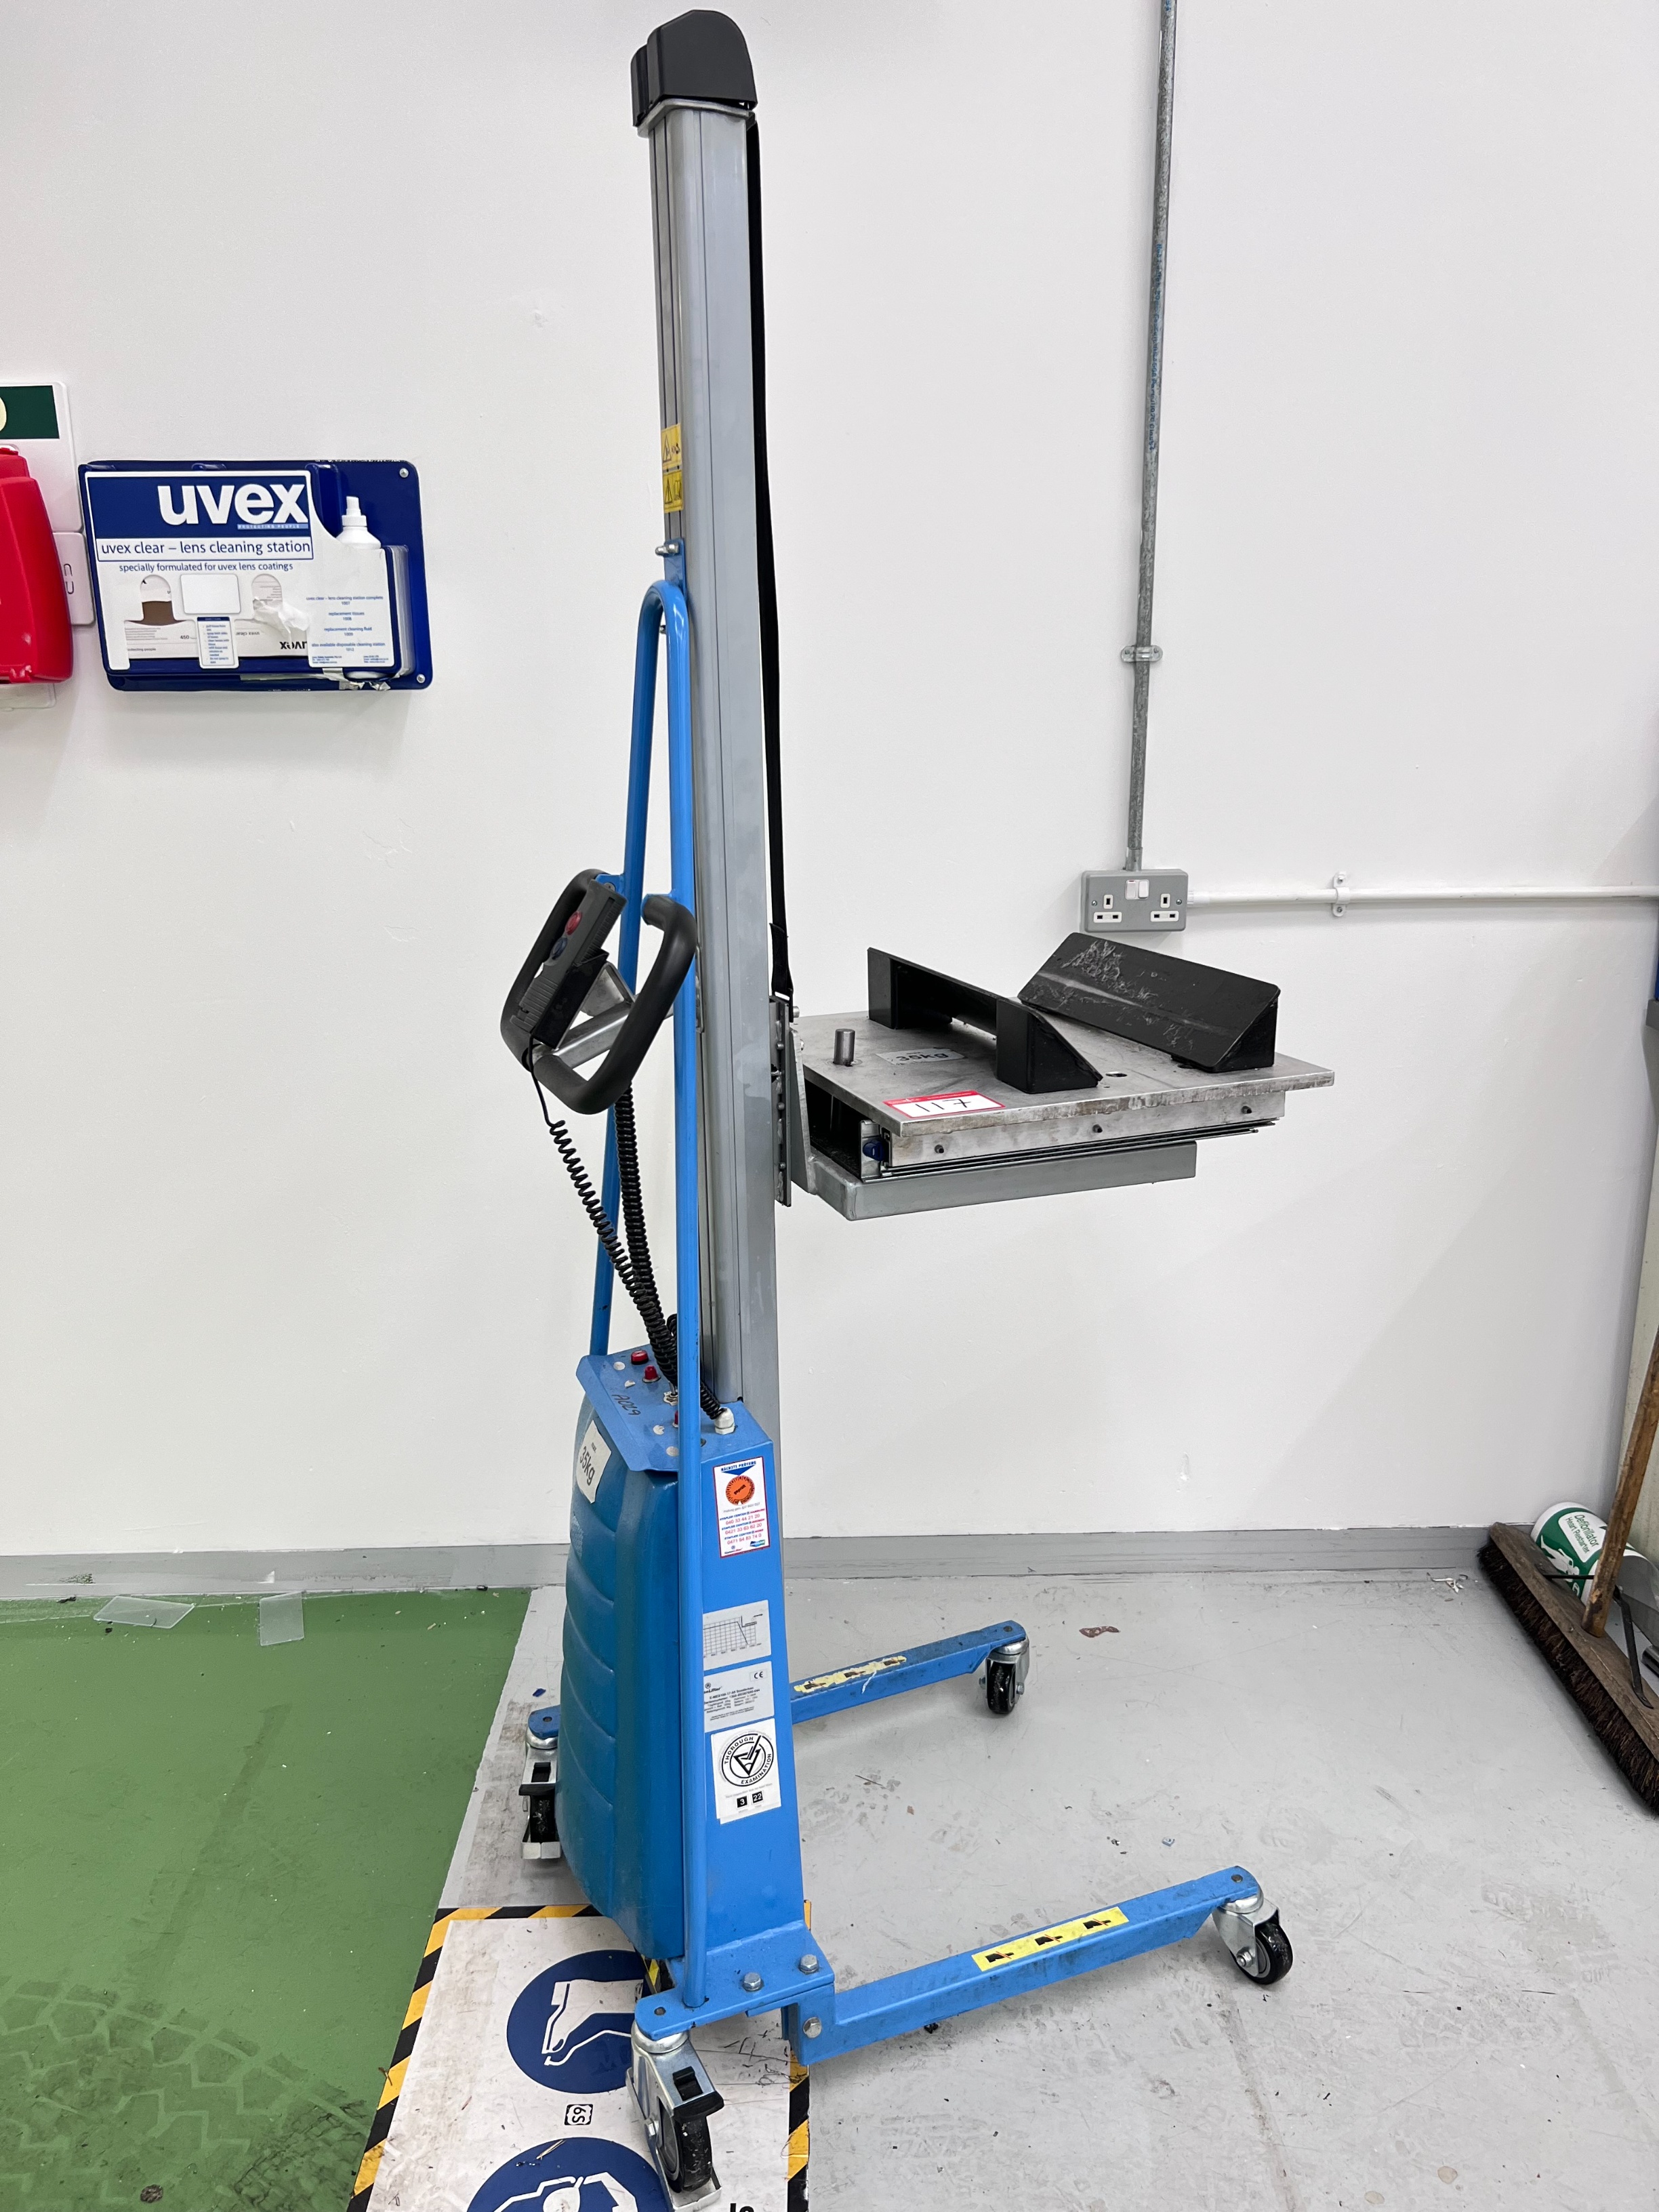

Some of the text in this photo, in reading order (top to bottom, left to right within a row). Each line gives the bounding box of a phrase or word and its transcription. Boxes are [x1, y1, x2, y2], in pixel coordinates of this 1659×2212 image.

[157, 483, 308, 525] uvex
[102, 544, 131, 554] uvex
[134, 541, 165, 554] clear
[180, 541, 205, 553] lens
[209, 541, 263, 555] cleaning
[267, 540, 310, 552] station
[119, 563, 155, 573] specially
[157, 562, 202, 571] formulated
[205, 562, 216, 571] for
[239, 562, 255, 571] lens
[258, 562, 293, 572] coatings
[896, 1053, 949, 1061] 35kg
[915, 1099, 971, 1112] 117
[579, 1446, 596, 1486] 35kg
[724, 1736, 754, 1765] THOROUGH
[741, 1753, 772, 1784] EXAMINATION
[753, 1793, 762, 1802] 22
